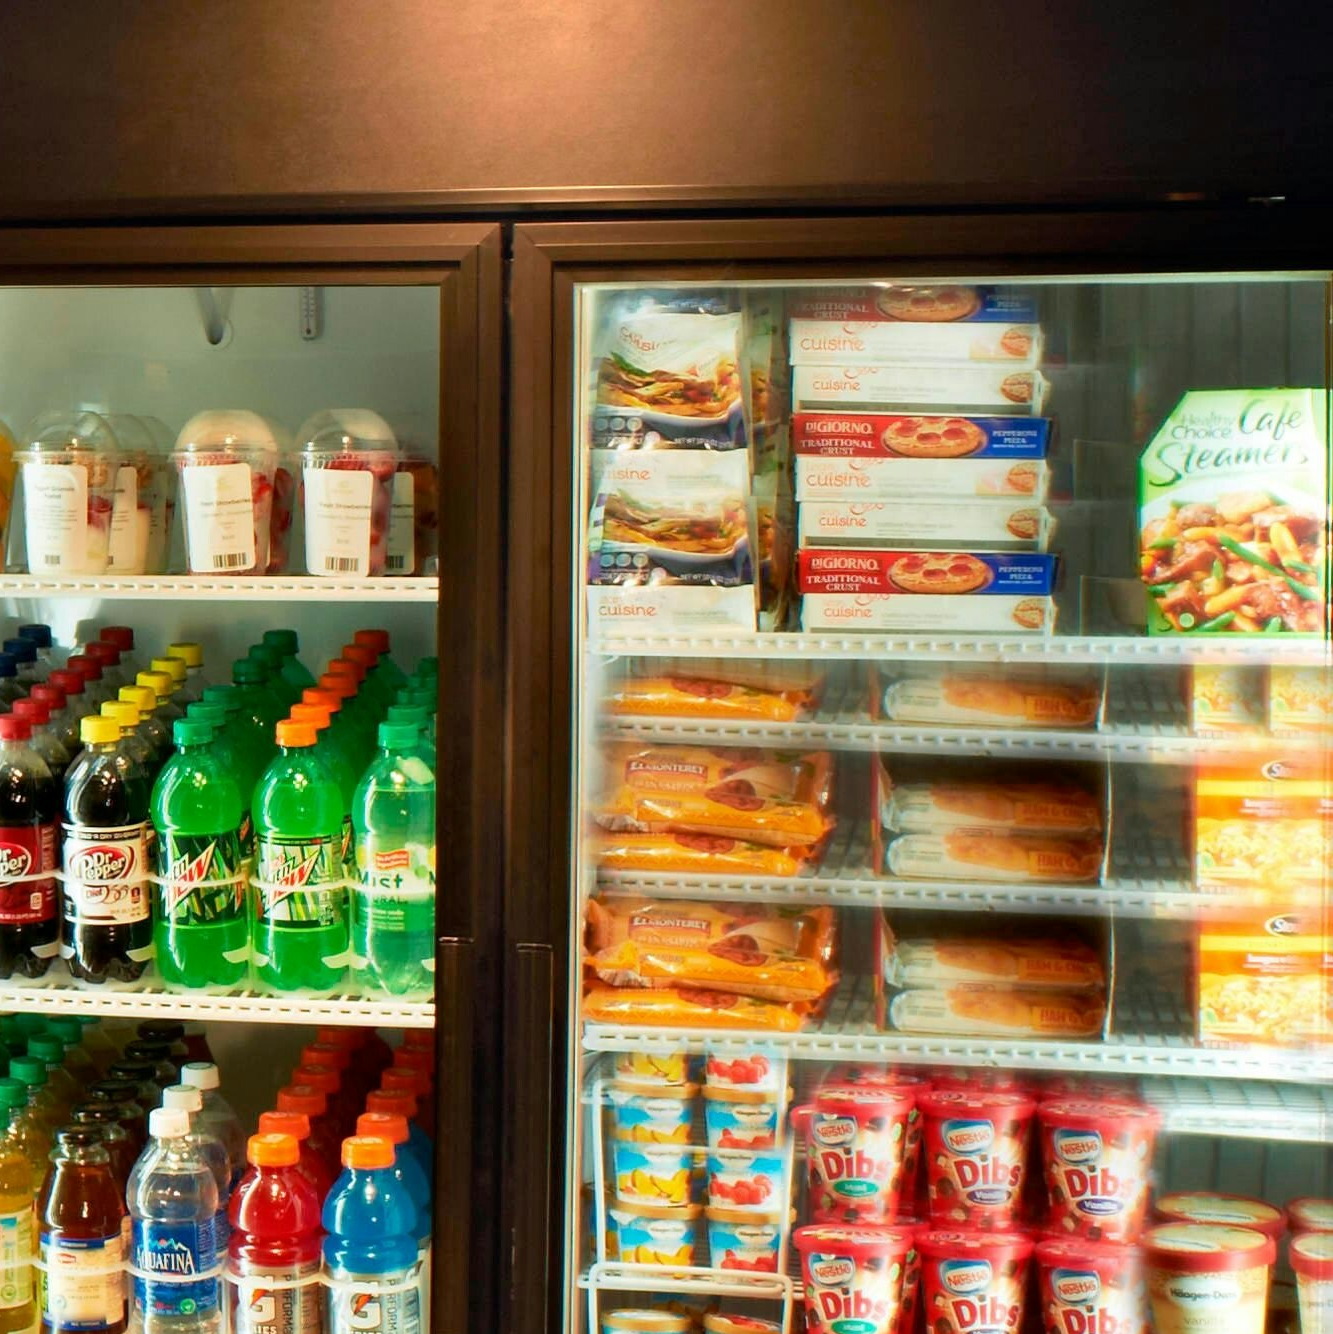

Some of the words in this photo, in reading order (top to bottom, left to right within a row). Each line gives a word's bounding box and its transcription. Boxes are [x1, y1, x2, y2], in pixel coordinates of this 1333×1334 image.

[1170, 423, 1232, 440] Choice
[1237, 398, 1304, 441] Cafe
[800, 438, 876, 450] TRADITIONAL
[805, 574, 882, 586] TRADITIONAL
[92, 851, 116, 869] Dr
[823, 1150, 892, 1181] Dibs
[954, 1157, 1022, 1188] Dibs
[1063, 1168, 1135, 1199] Dibs
[819, 1290, 890, 1321] Dibs
[951, 1299, 1020, 1329] Dibs
